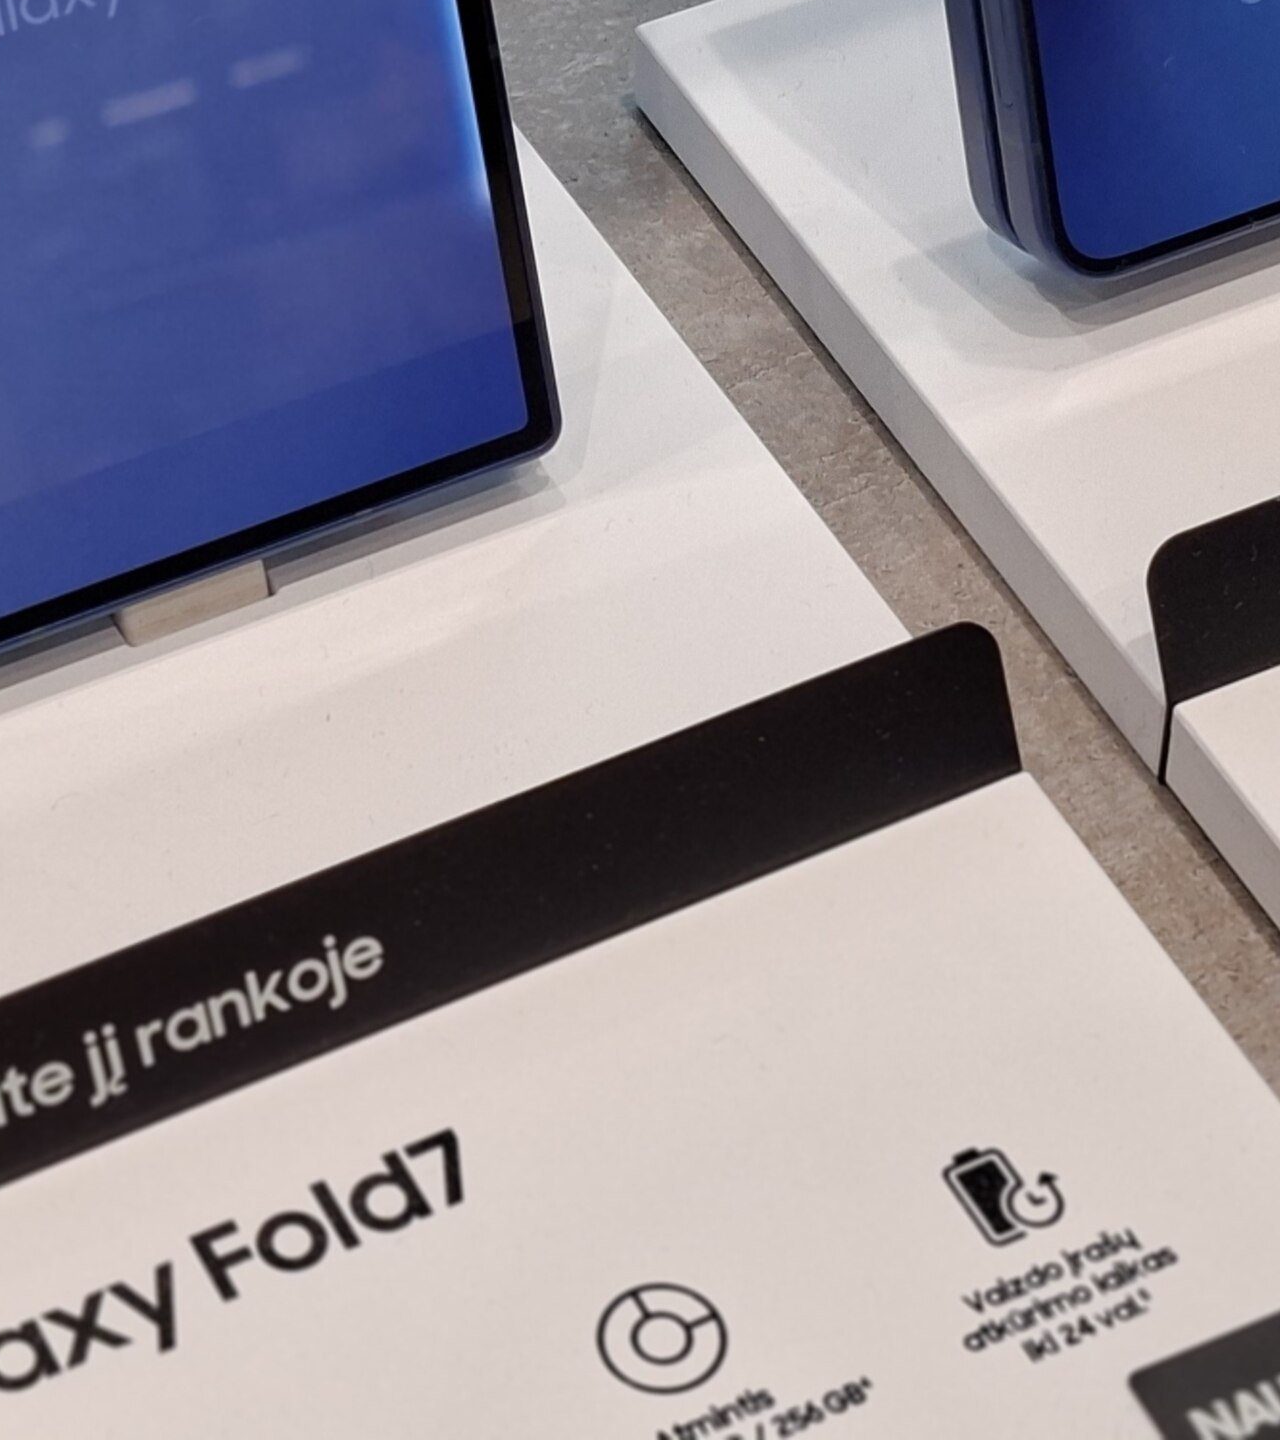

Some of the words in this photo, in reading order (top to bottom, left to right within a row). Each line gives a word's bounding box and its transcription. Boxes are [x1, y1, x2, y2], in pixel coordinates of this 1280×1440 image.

[83, 1024, 127, 1107] jį
[134, 933, 385, 1068] rankoje
[190, 1127, 467, 1303] Fold7
[960, 1262, 1065, 1315] Vaizdo
[962, 1283, 1094, 1353] atkūrimo
[1058, 1316, 1098, 1347] 24
[770, 1400, 826, 1439] 256
